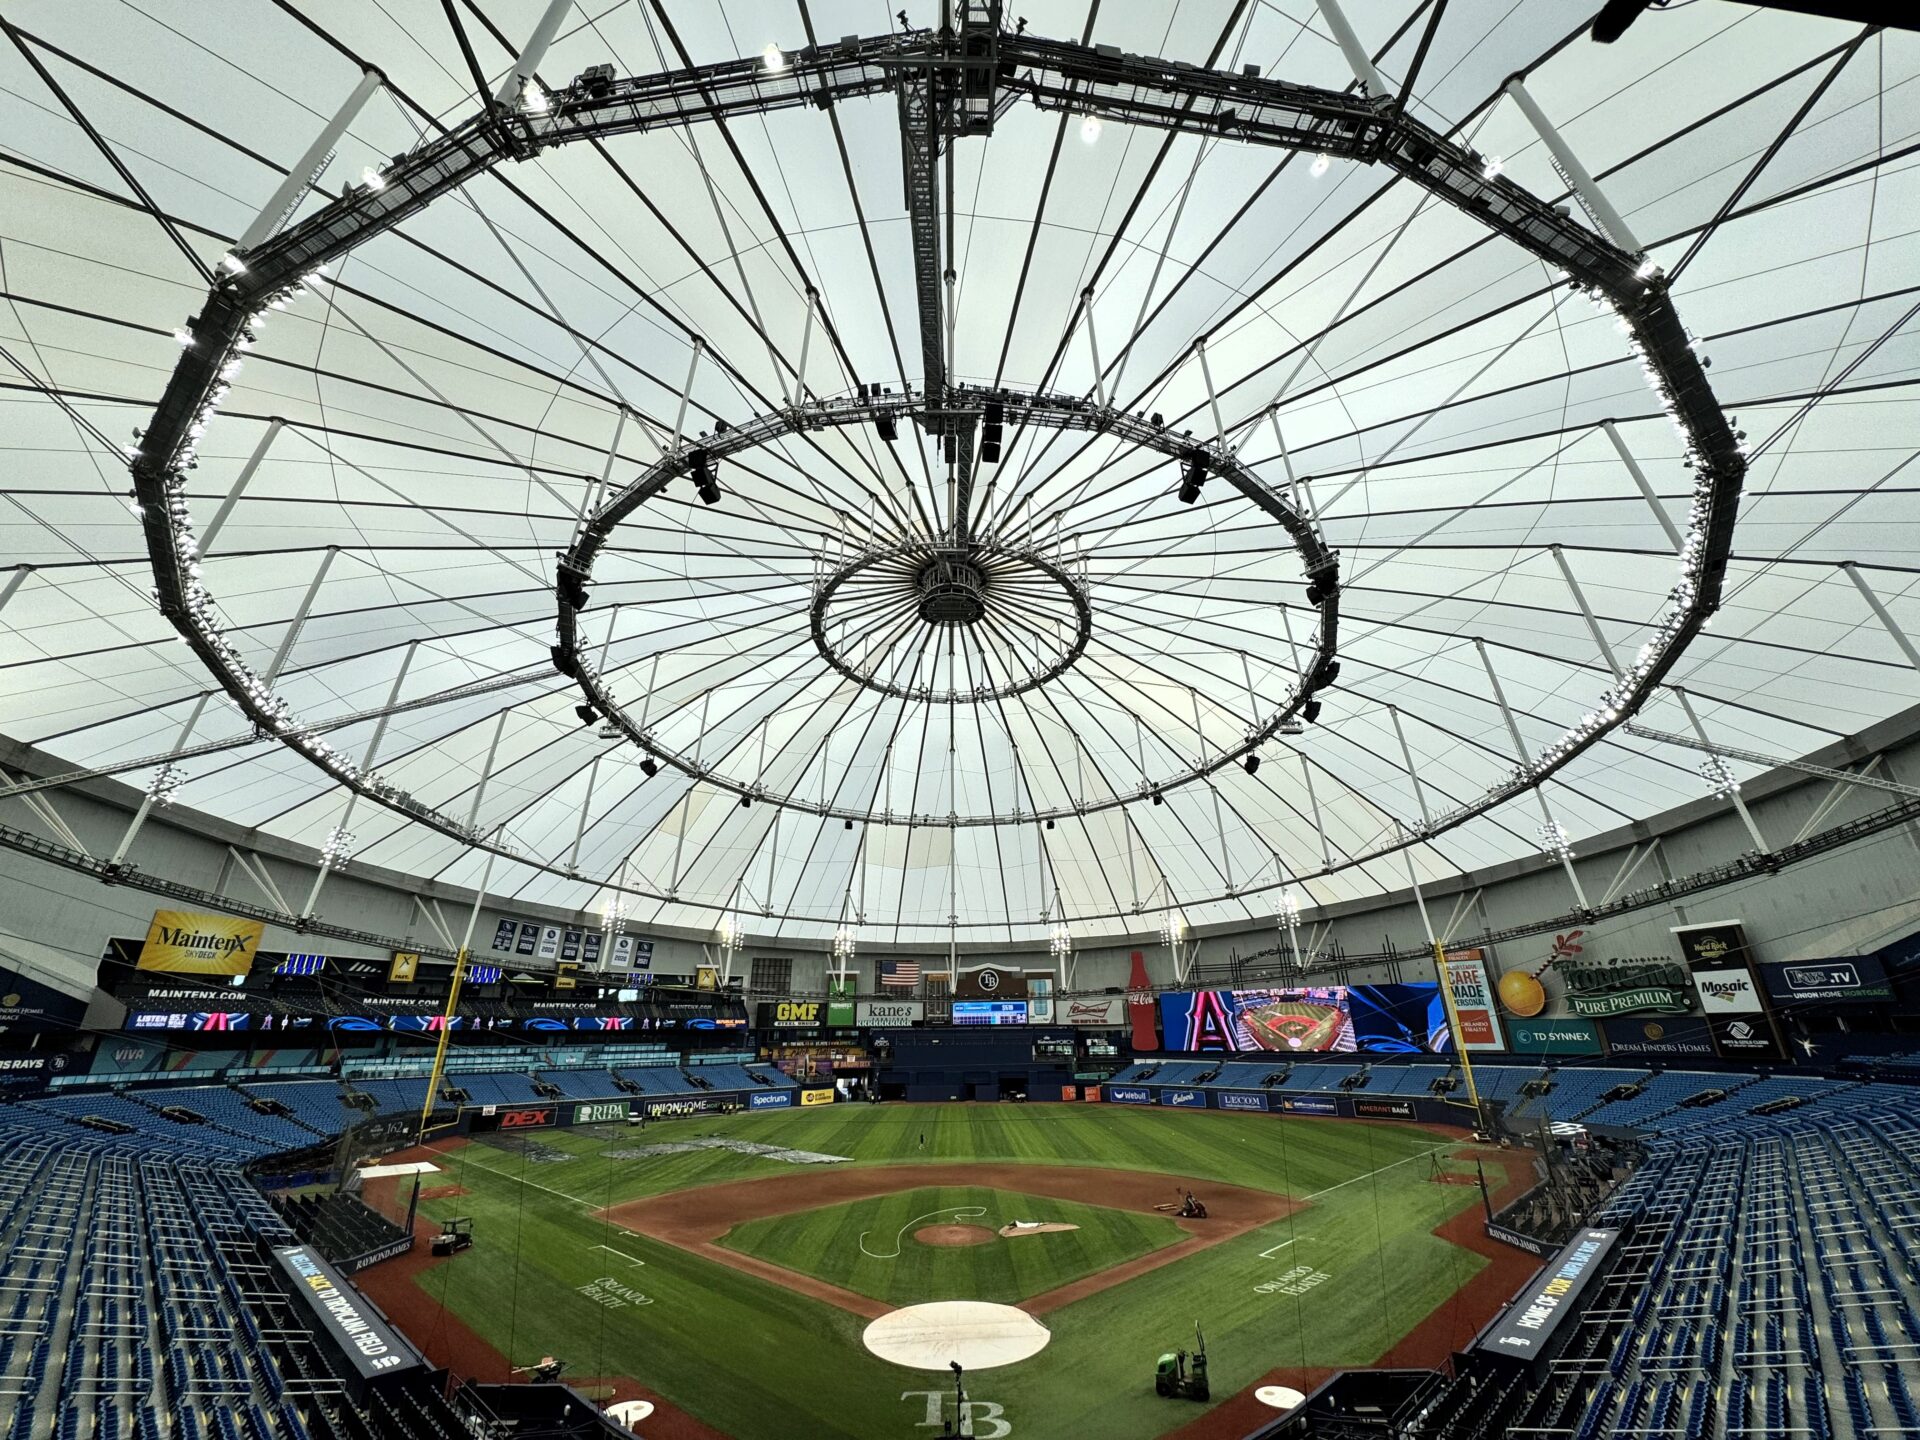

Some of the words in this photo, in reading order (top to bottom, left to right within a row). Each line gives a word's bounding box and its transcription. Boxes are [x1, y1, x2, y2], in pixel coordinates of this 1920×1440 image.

[155, 925, 253, 960] MaintenX
[184, 949, 217, 959] SKYDECK
[982, 973, 996, 987] TB
[1447, 969, 1482, 985] CARE
[1552, 960, 1686, 992] Tropicana
[1450, 985, 1485, 998] MADE
[1701, 978, 1749, 993] Mosaic
[1843, 988, 1889, 997] MORTGAGE
[148, 989, 247, 1001] MAINTENX.COM
[362, 998, 440, 1007] MAINTENX.COM
[533, 1002, 597, 1010] MAINTENX.COM
[1574, 1000, 1610, 1014] PURE
[1609, 991, 1674, 1012] PREMIUM
[776, 1003, 819, 1021] GMF
[868, 1003, 913, 1017] kane's
[136, 1014, 168, 1022] LISTEN
[1532, 1032, 1547, 1041] TD
[1548, 1032, 1591, 1041] SYNNEX
[115, 1048, 145, 1061] VIVA
[1611, 1042, 1642, 1053] DREAM
[1641, 1043, 1678, 1054] FINDERS
[1679, 1044, 1712, 1053] HOMES
[11, 1059, 45, 1069] RAYS
[753, 1095, 784, 1105] Spectrum
[1124, 1091, 1147, 1100] Webull
[1224, 1095, 1260, 1105] LECOM
[591, 1103, 625, 1121] RIPA
[1359, 1104, 1392, 1113] AMERANT
[1391, 1106, 1410, 1114] BANK
[501, 1109, 550, 1127] DEX
[355, 1249, 391, 1270] RAYMOND
[305, 1274, 335, 1292] BACK
[1253, 1265, 1314, 1294] ORLANDO
[1279, 1270, 1333, 1297] HEALTH
[316, 1287, 341, 1299] TO
[594, 1277, 655, 1306] ORLANDO
[1541, 1278, 1574, 1297] YOUR
[576, 1283, 627, 1309] HEALTH
[1534, 1294, 1560, 1307] OF
[323, 1295, 370, 1336] TROPICANA
[1516, 1304, 1554, 1330] HOME
[352, 1331, 388, 1356] FIELD
[900, 1390, 1012, 1440] TB
